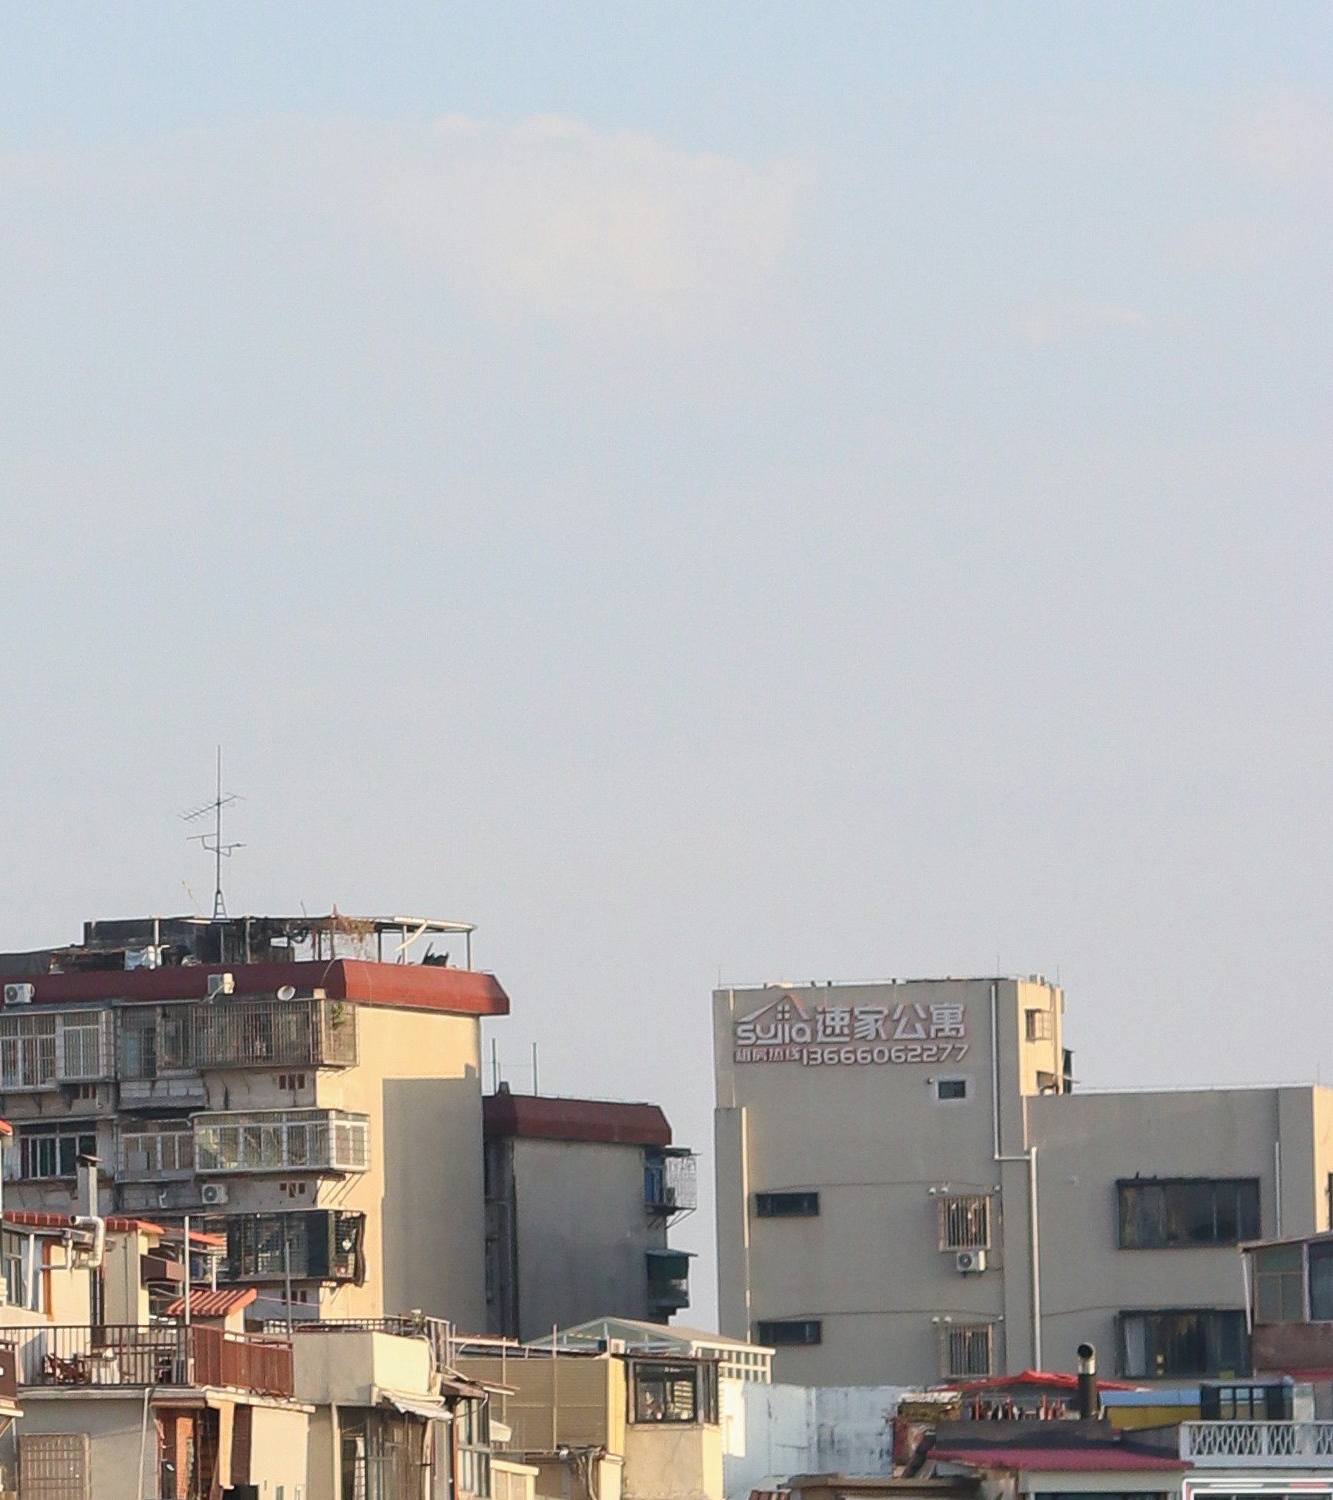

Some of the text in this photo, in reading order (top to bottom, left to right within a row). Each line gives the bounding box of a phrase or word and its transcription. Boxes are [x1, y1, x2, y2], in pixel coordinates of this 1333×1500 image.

[815, 1002, 967, 1043] 速家公寓
[802, 1044, 970, 1066] 13666062277
